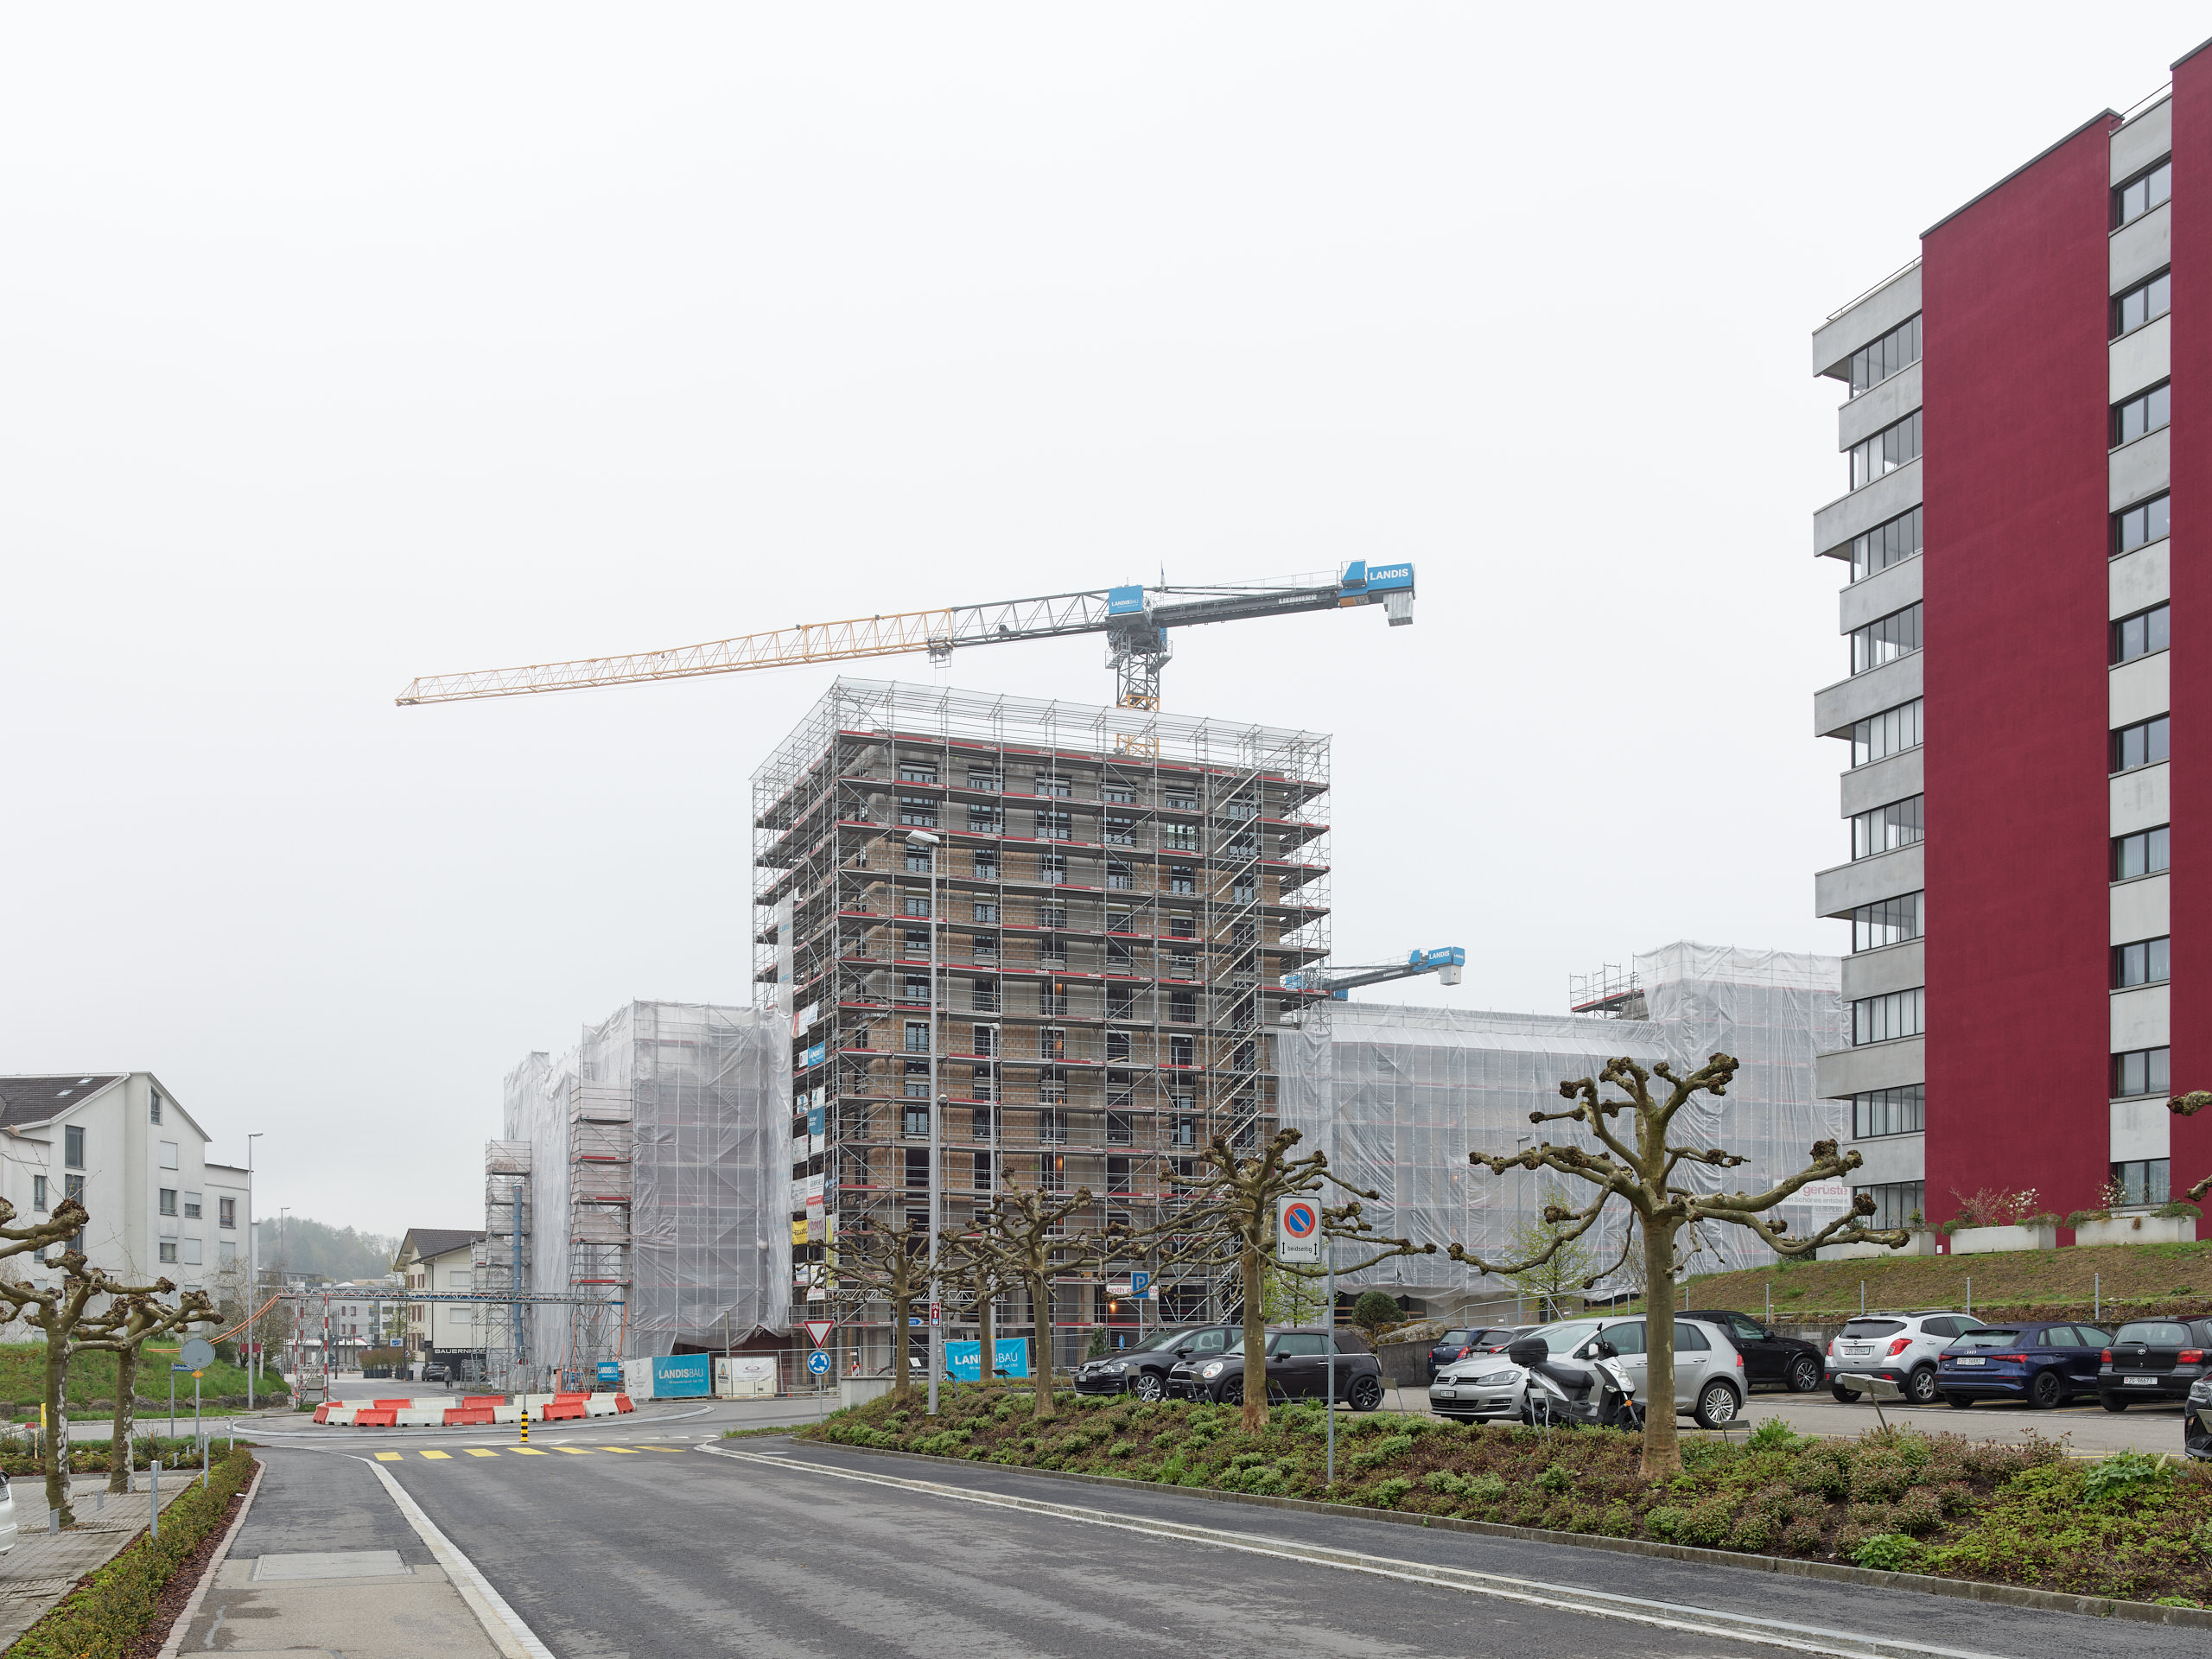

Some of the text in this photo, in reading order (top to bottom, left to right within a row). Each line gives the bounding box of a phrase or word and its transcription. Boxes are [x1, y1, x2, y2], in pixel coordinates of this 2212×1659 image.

[1370, 569, 1409, 581] LANDIS
[1278, 594, 1318, 605] LIEBHERR
[1428, 950, 1450, 960] LANDIS
[1803, 1185, 1848, 1197] gerüste
[1287, 1245, 1313, 1254] beidseitig
[1136, 1275, 1146, 1289] P
[954, 1351, 1019, 1365] LANBAU
[658, 1368, 704, 1380] LANDISBAU
